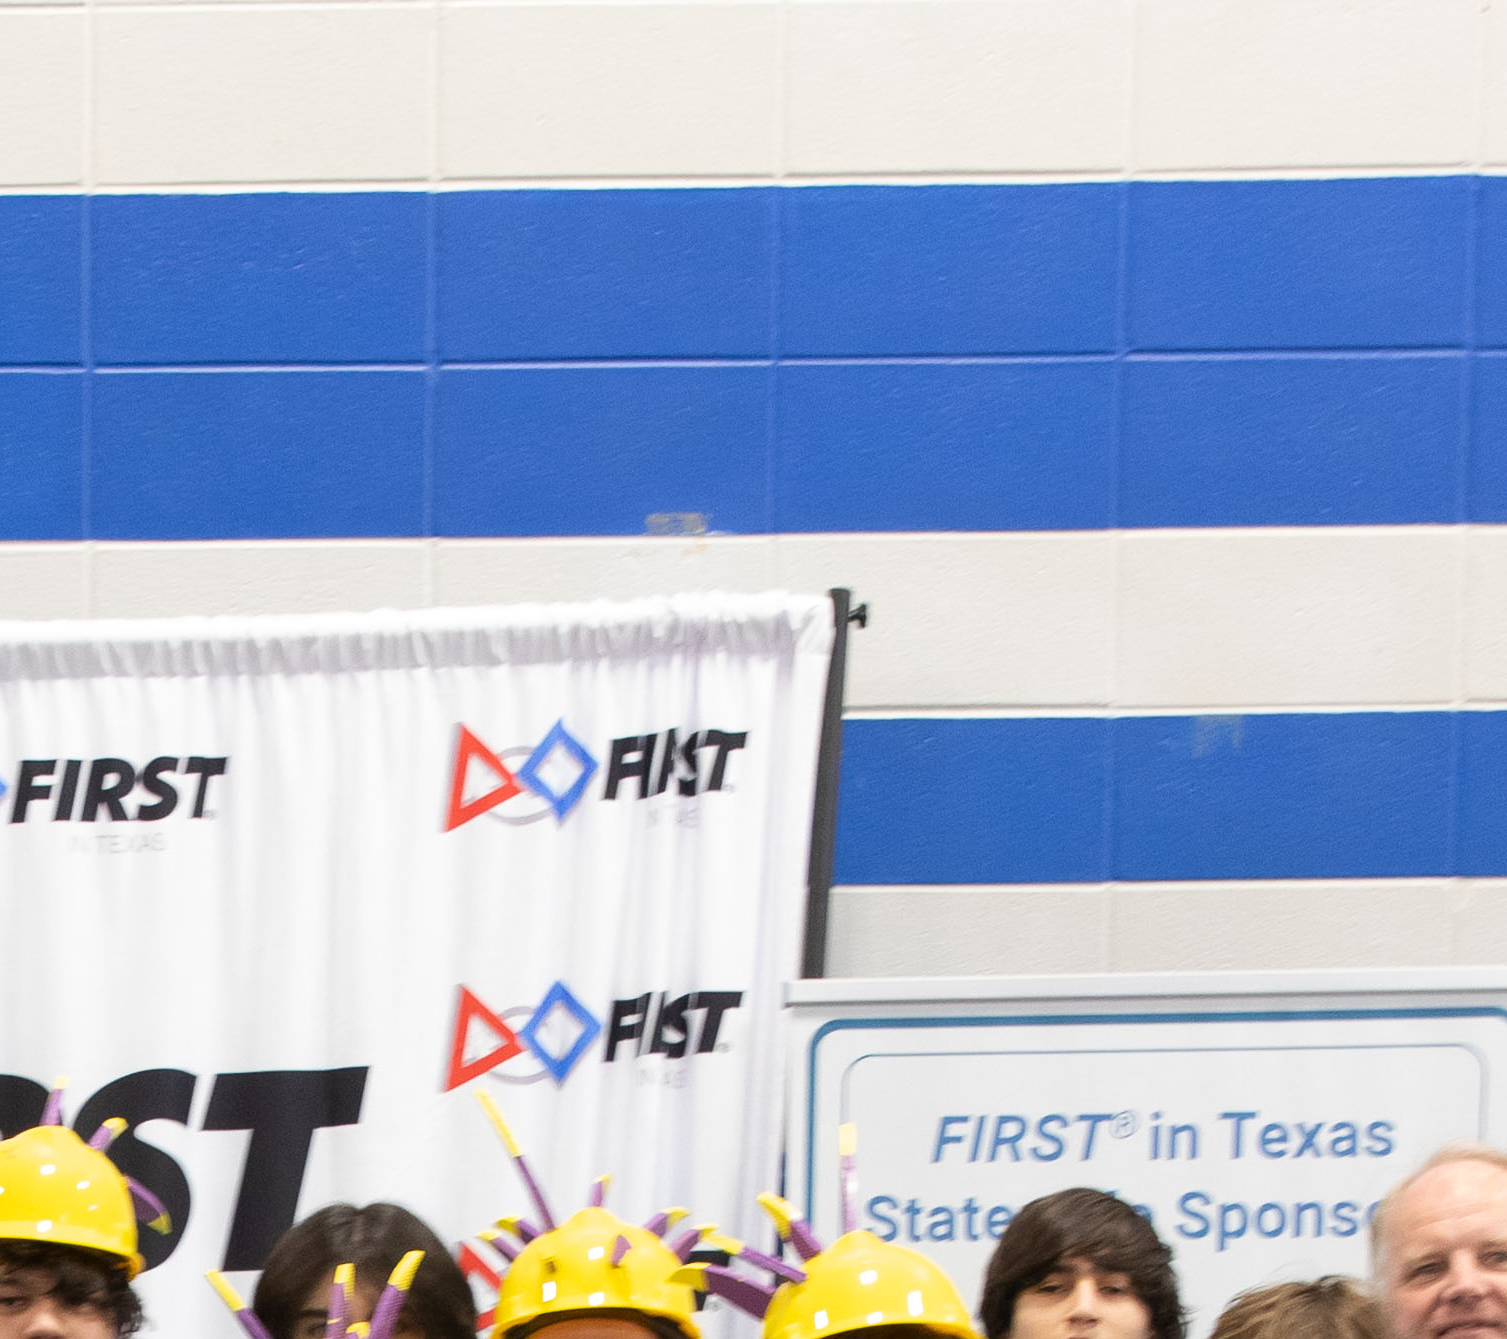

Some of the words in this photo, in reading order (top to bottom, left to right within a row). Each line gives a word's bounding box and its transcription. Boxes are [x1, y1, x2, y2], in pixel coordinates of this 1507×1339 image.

[9, 756, 229, 824] FIRST
[1148, 1112, 1199, 1160] in
[1218, 1110, 1397, 1159] Texas
